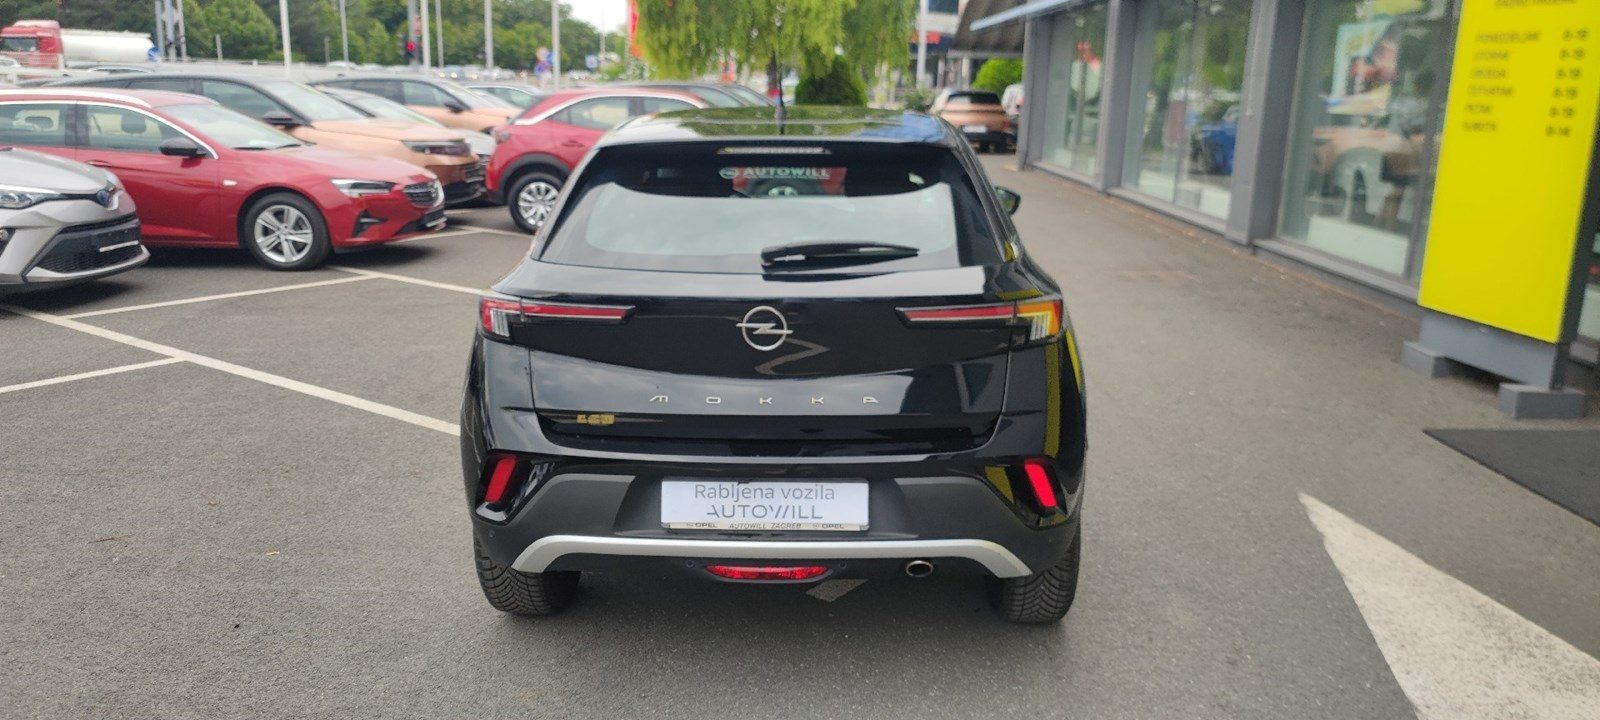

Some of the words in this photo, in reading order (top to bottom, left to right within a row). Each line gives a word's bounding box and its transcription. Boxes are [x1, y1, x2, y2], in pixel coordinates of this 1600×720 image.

[744, 167, 831, 179] AUTOWILL
[649, 394, 880, 405] MOKKA
[694, 483, 775, 503] Rabljena
[780, 484, 836, 500] vozila
[706, 504, 824, 520] AUTOWILL
[729, 522, 767, 530] AUTOWILL
[770, 522, 802, 530] ZAGREB
